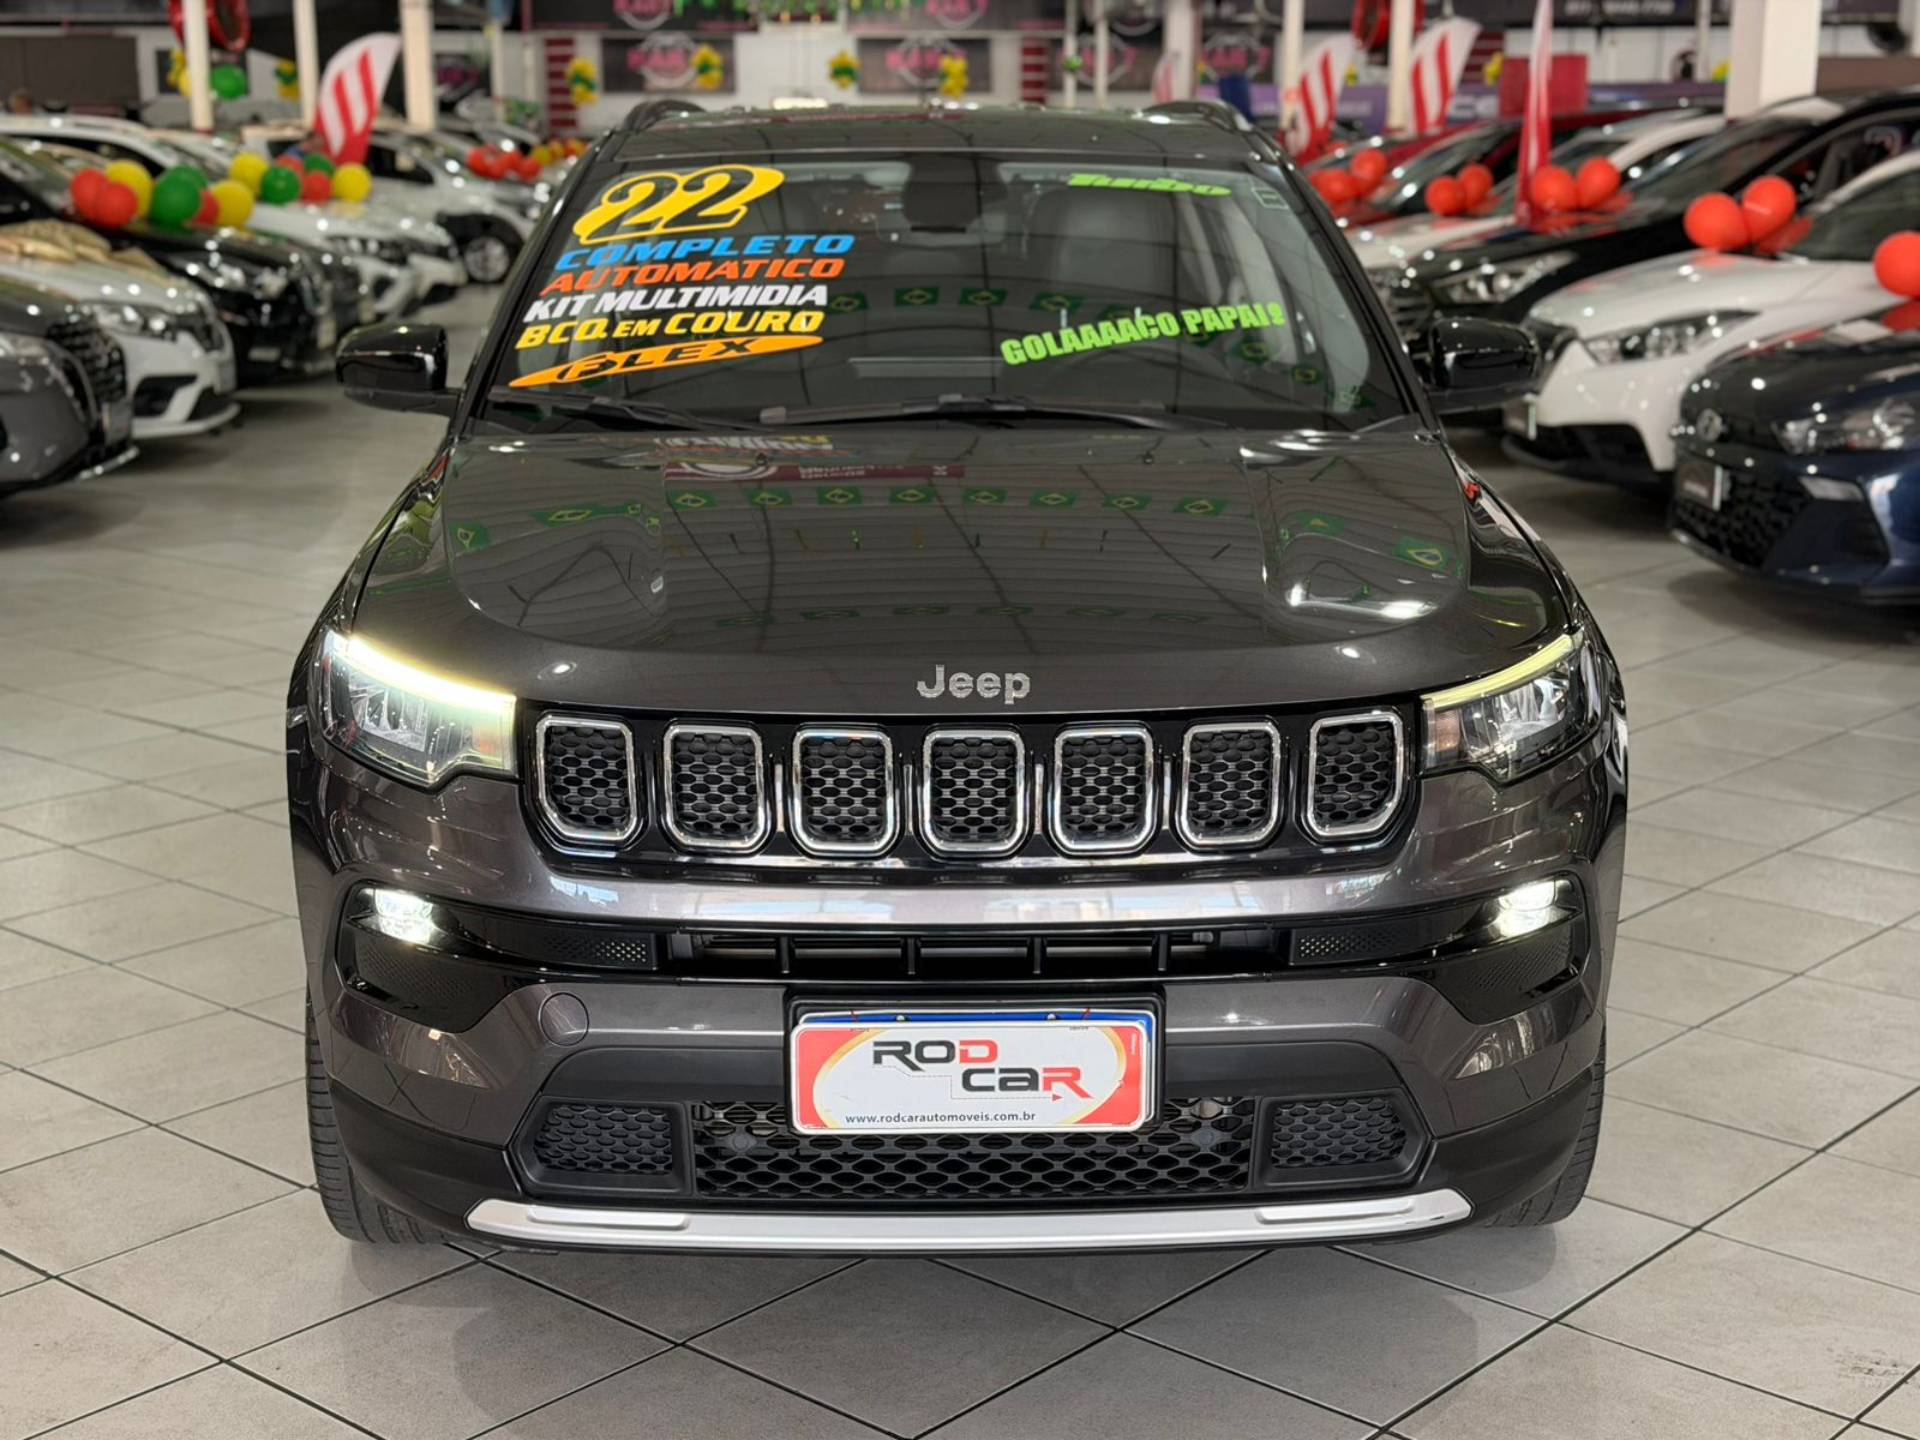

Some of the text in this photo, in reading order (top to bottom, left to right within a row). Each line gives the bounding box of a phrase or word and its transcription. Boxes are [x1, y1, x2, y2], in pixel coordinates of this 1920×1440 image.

[573, 164, 785, 246] 22
[554, 234, 856, 271] COMPLETO
[539, 258, 845, 297] AUTOMATICO
[523, 294, 600, 324] KIT
[612, 318, 662, 338] EM
[664, 310, 825, 335] COURO
[557, 338, 758, 381] FLEX
[916, 664, 1031, 705] Jeep
[872, 1039, 999, 1072] ROD
[845, 1111, 1036, 1123] www.rodcarautomoveis.com.br
